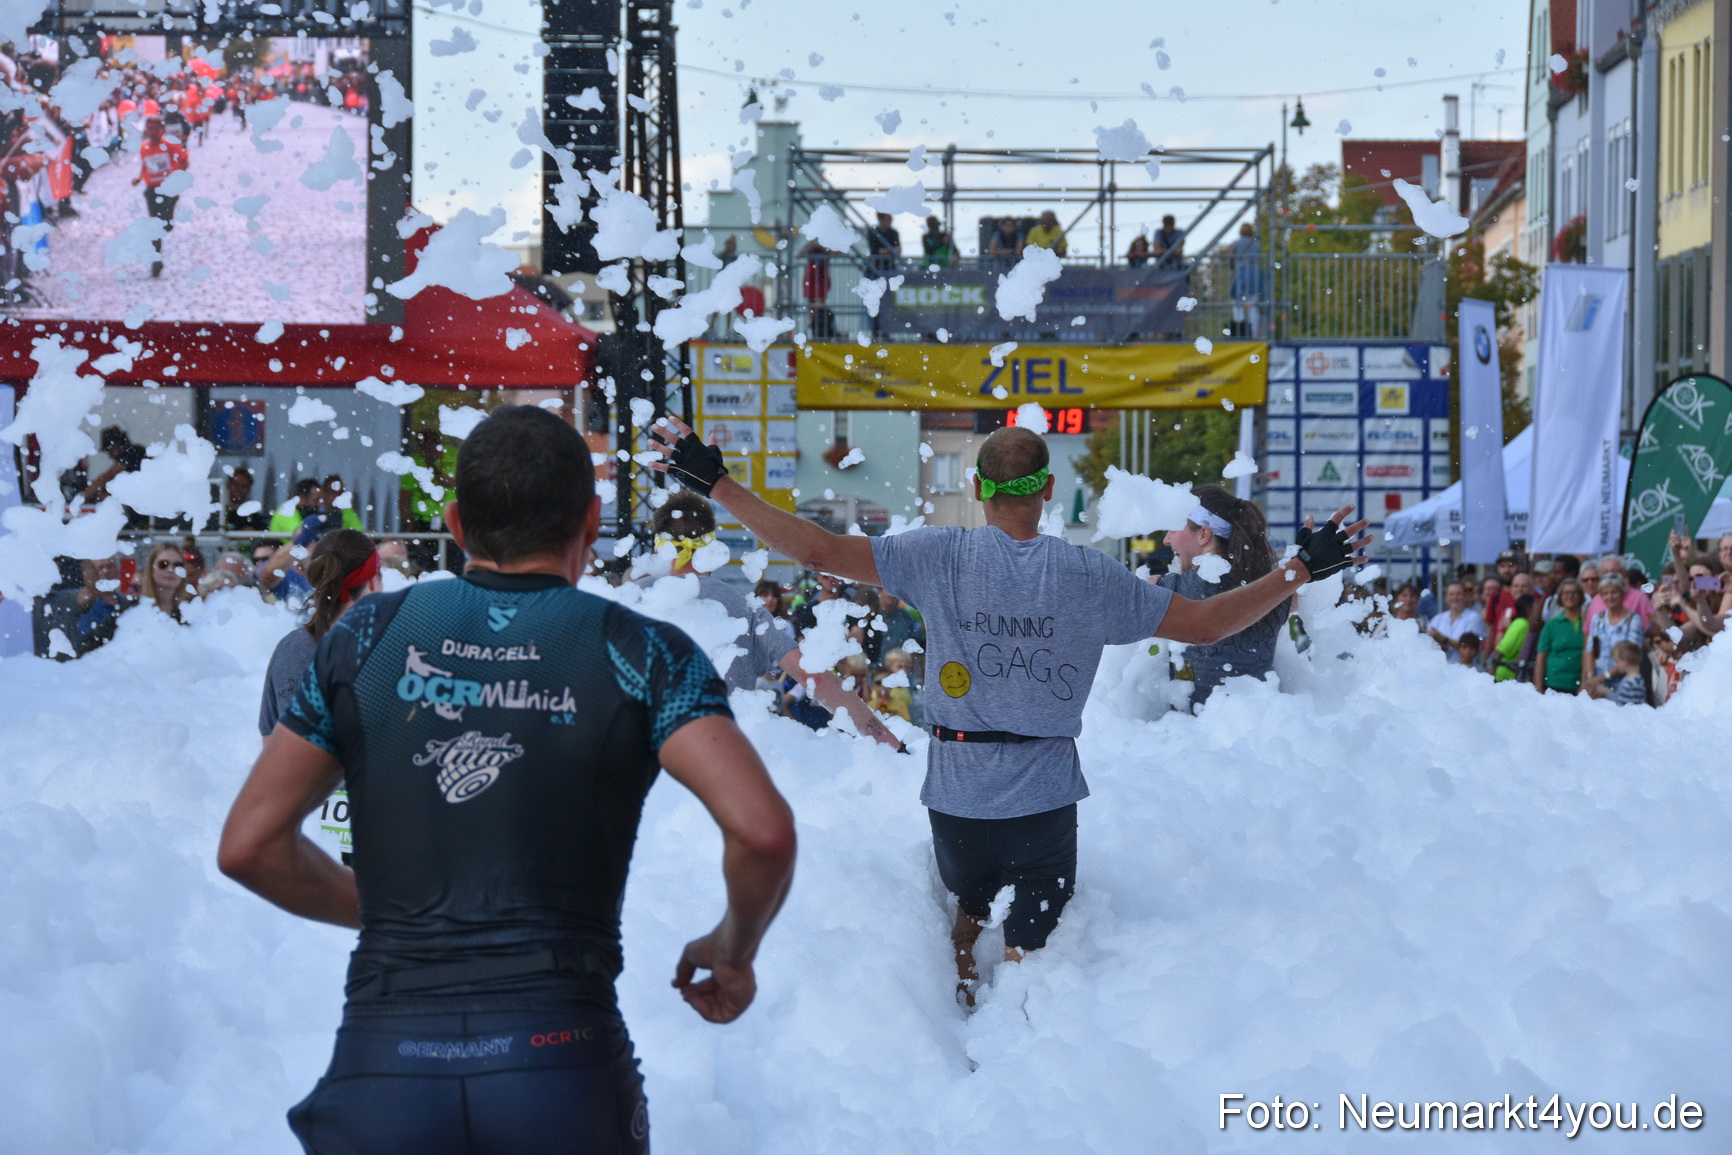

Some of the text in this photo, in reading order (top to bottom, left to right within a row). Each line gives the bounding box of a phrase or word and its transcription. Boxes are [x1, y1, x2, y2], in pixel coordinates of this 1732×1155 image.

[894, 286, 986, 305] BOCK
[980, 358, 1085, 395] ZIEL
[1681, 443, 1725, 492] AOK
[1600, 439, 1613, 545] PARTL NEUMARKT
[1626, 477, 1681, 531] AOK
[956, 618, 972, 632] THE
[441, 639, 541, 661] DURACELL
[977, 643, 1079, 701] GAGS
[398, 1036, 513, 1058] GERMANY
